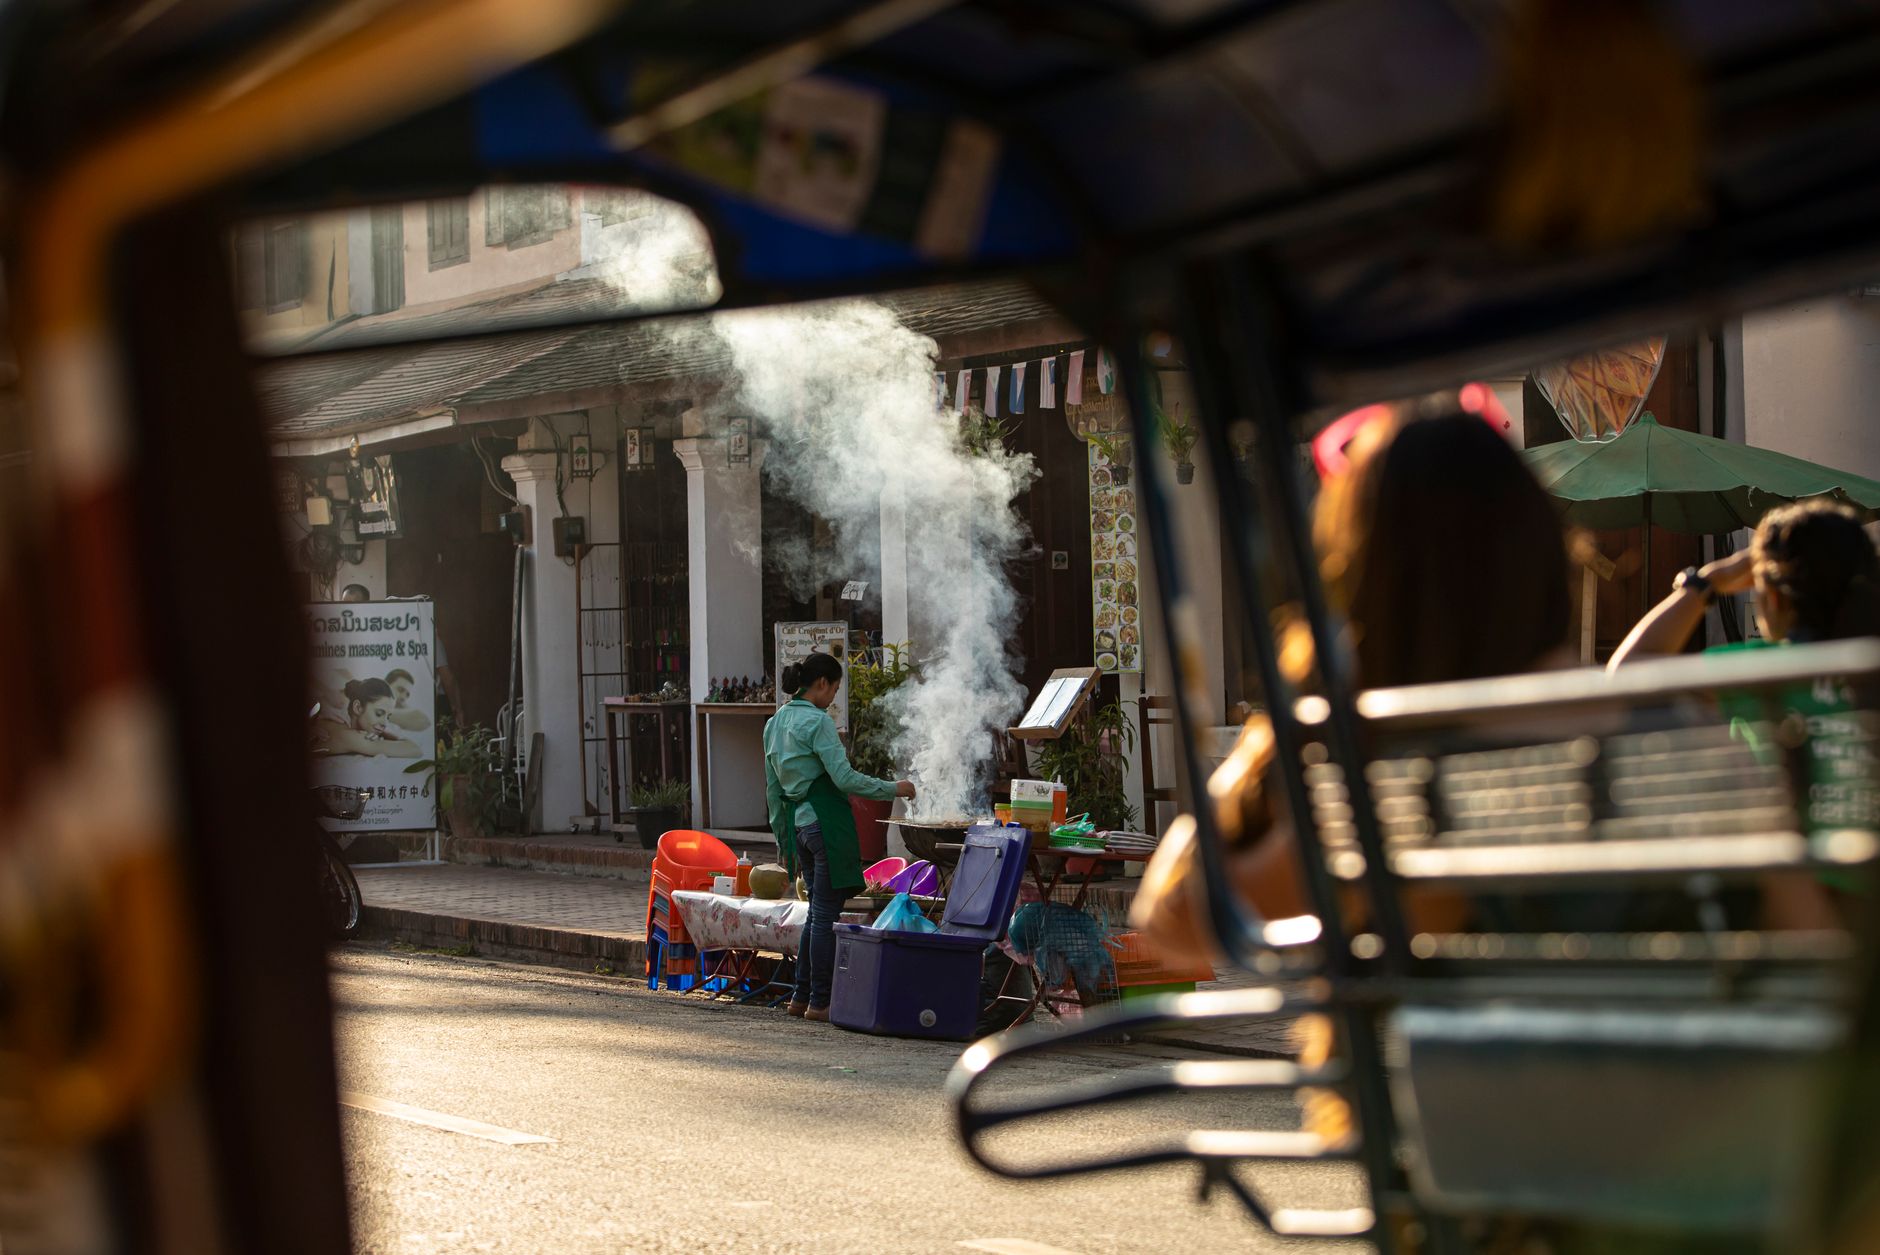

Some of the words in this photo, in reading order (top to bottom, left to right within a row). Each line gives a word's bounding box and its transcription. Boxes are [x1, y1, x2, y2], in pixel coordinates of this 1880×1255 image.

[349, 642, 393, 660] massage
[396, 640, 405, 656] &
[408, 640, 428, 660] Spa
